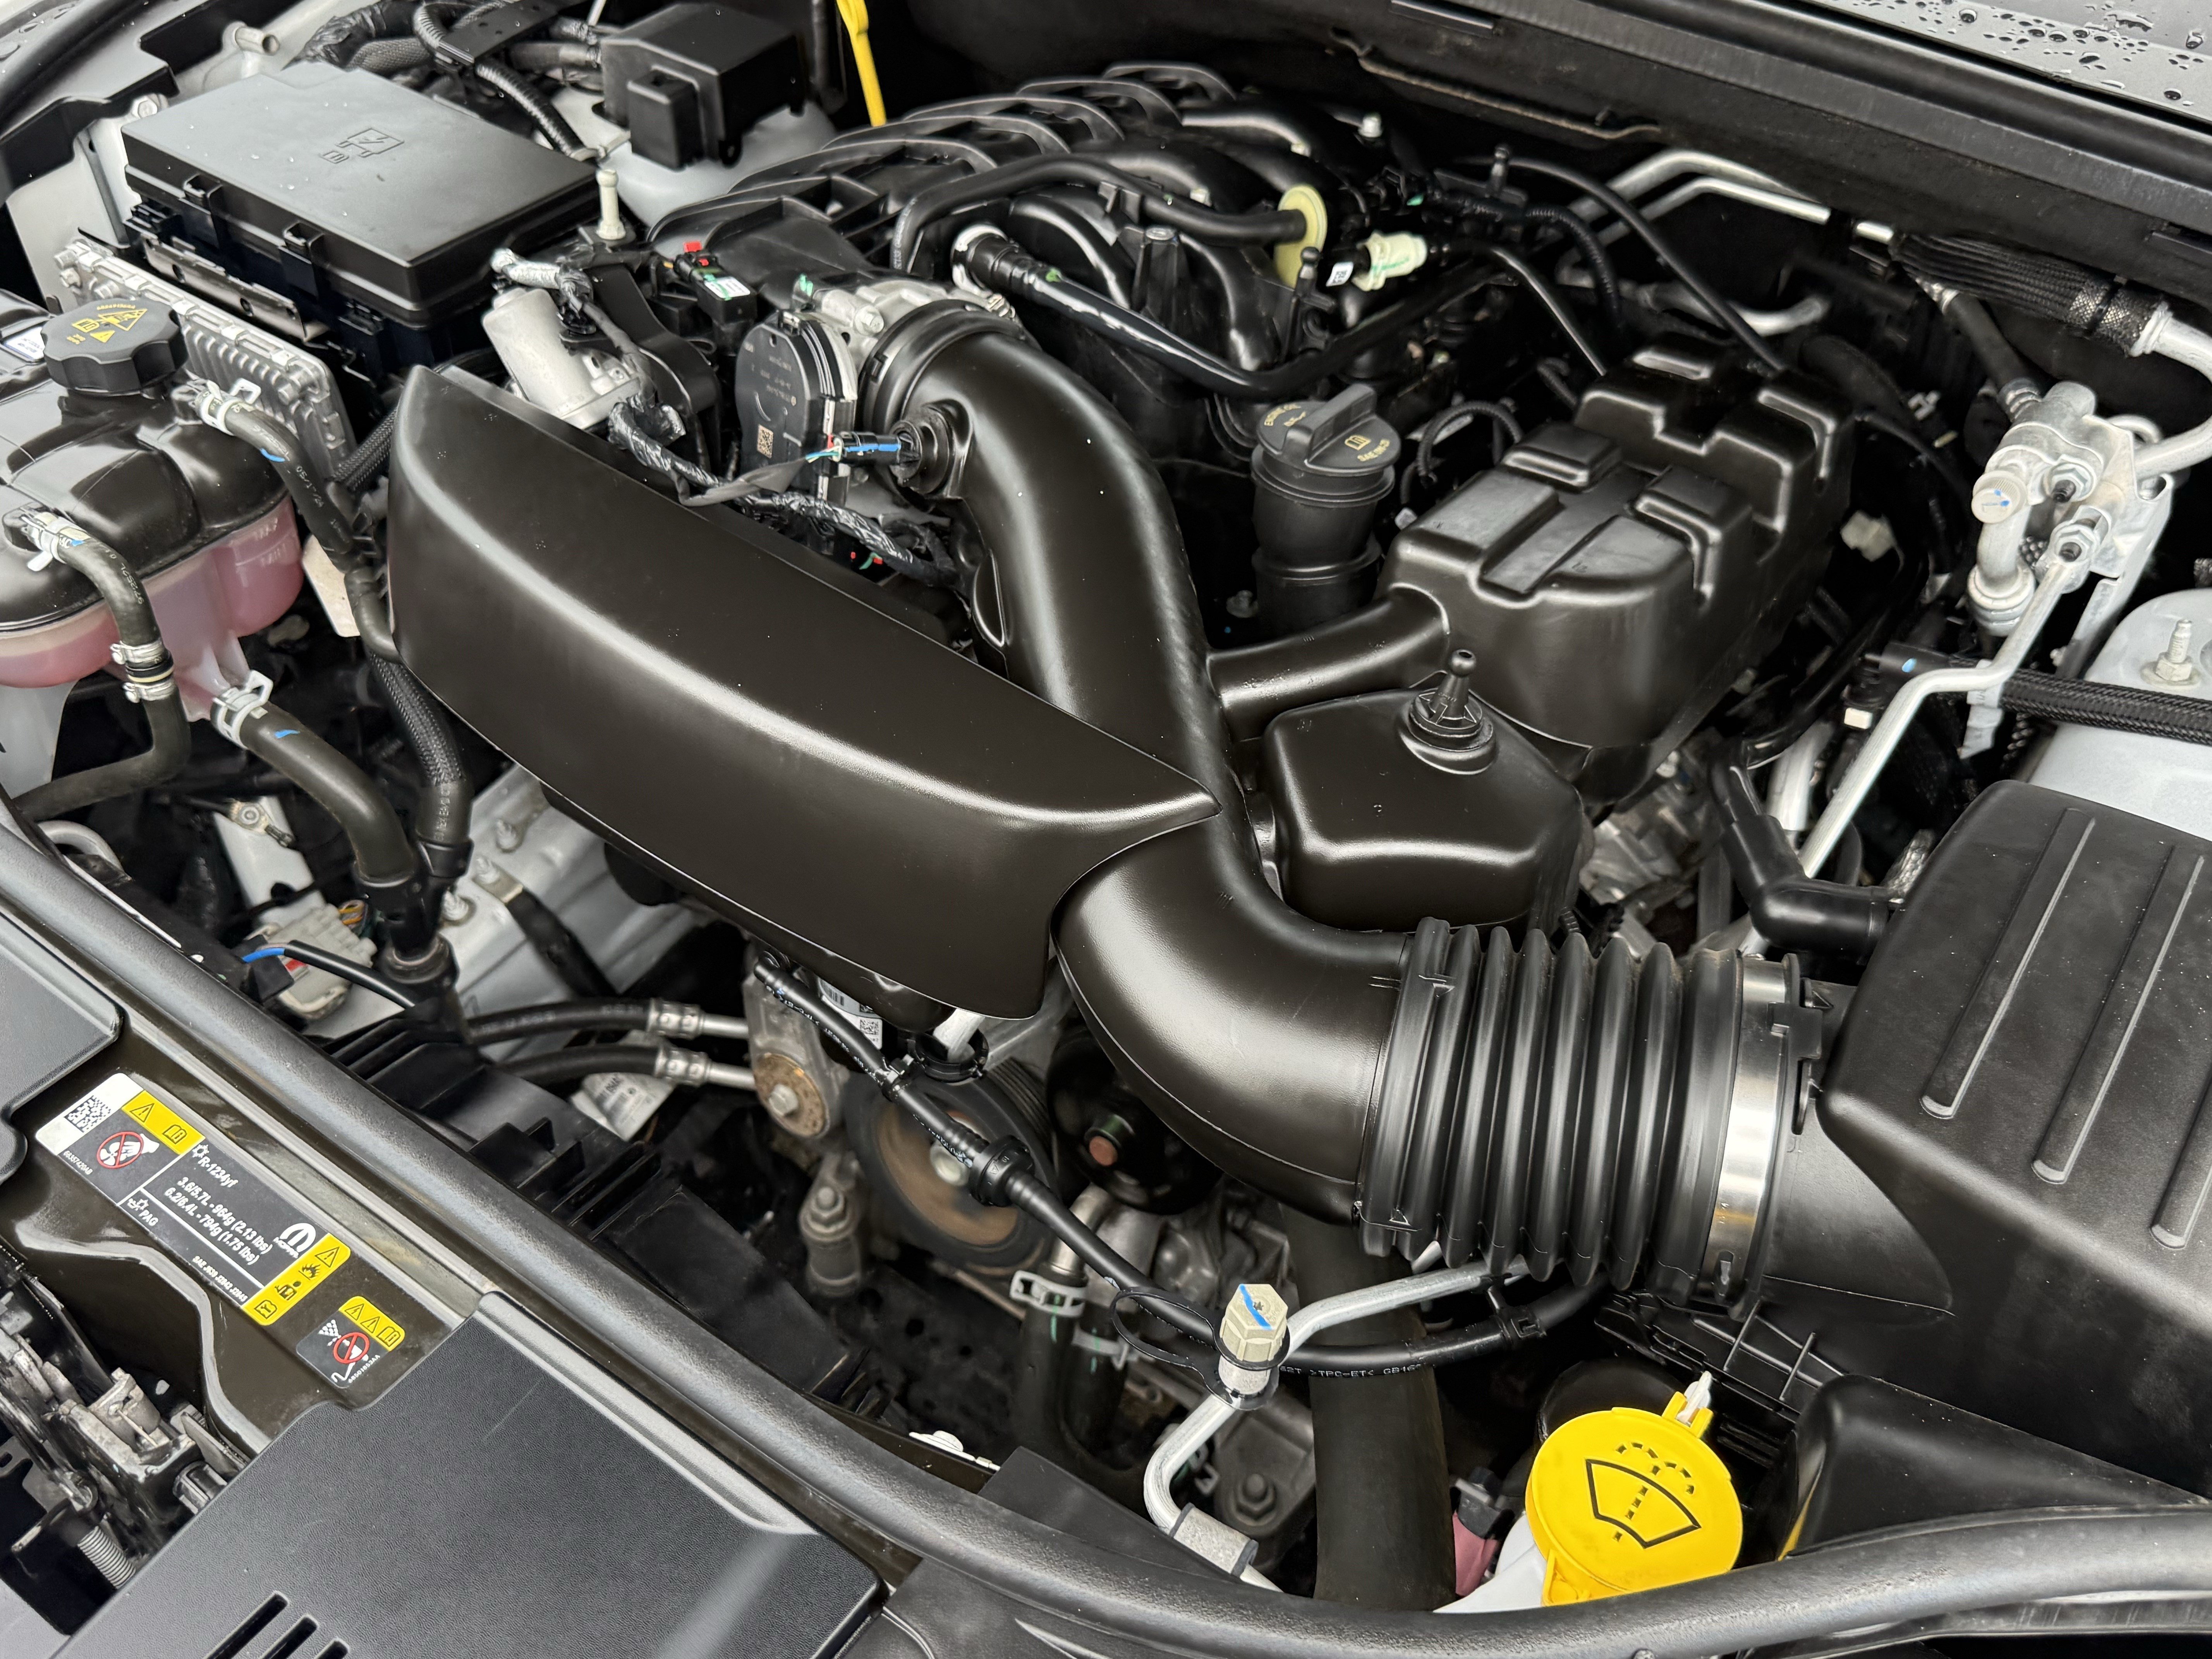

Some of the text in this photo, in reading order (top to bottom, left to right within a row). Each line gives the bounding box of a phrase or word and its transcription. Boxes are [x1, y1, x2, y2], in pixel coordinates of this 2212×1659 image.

[197, 1156, 239, 1188] R-1234yf
[139, 1209, 159, 1226] PAG
[163, 1187, 198, 1216] 6.2/6.4L
[199, 1214, 223, 1237] 794g
[217, 1231, 245, 1251] (1.75
[238, 1246, 260, 1266] lbs)
[177, 1176, 211, 1206] 3.6/5.7L
[212, 1204, 236, 1226] 964g
[230, 1220, 258, 1241] (2.13
[251, 1235, 273, 1255] lbs)
